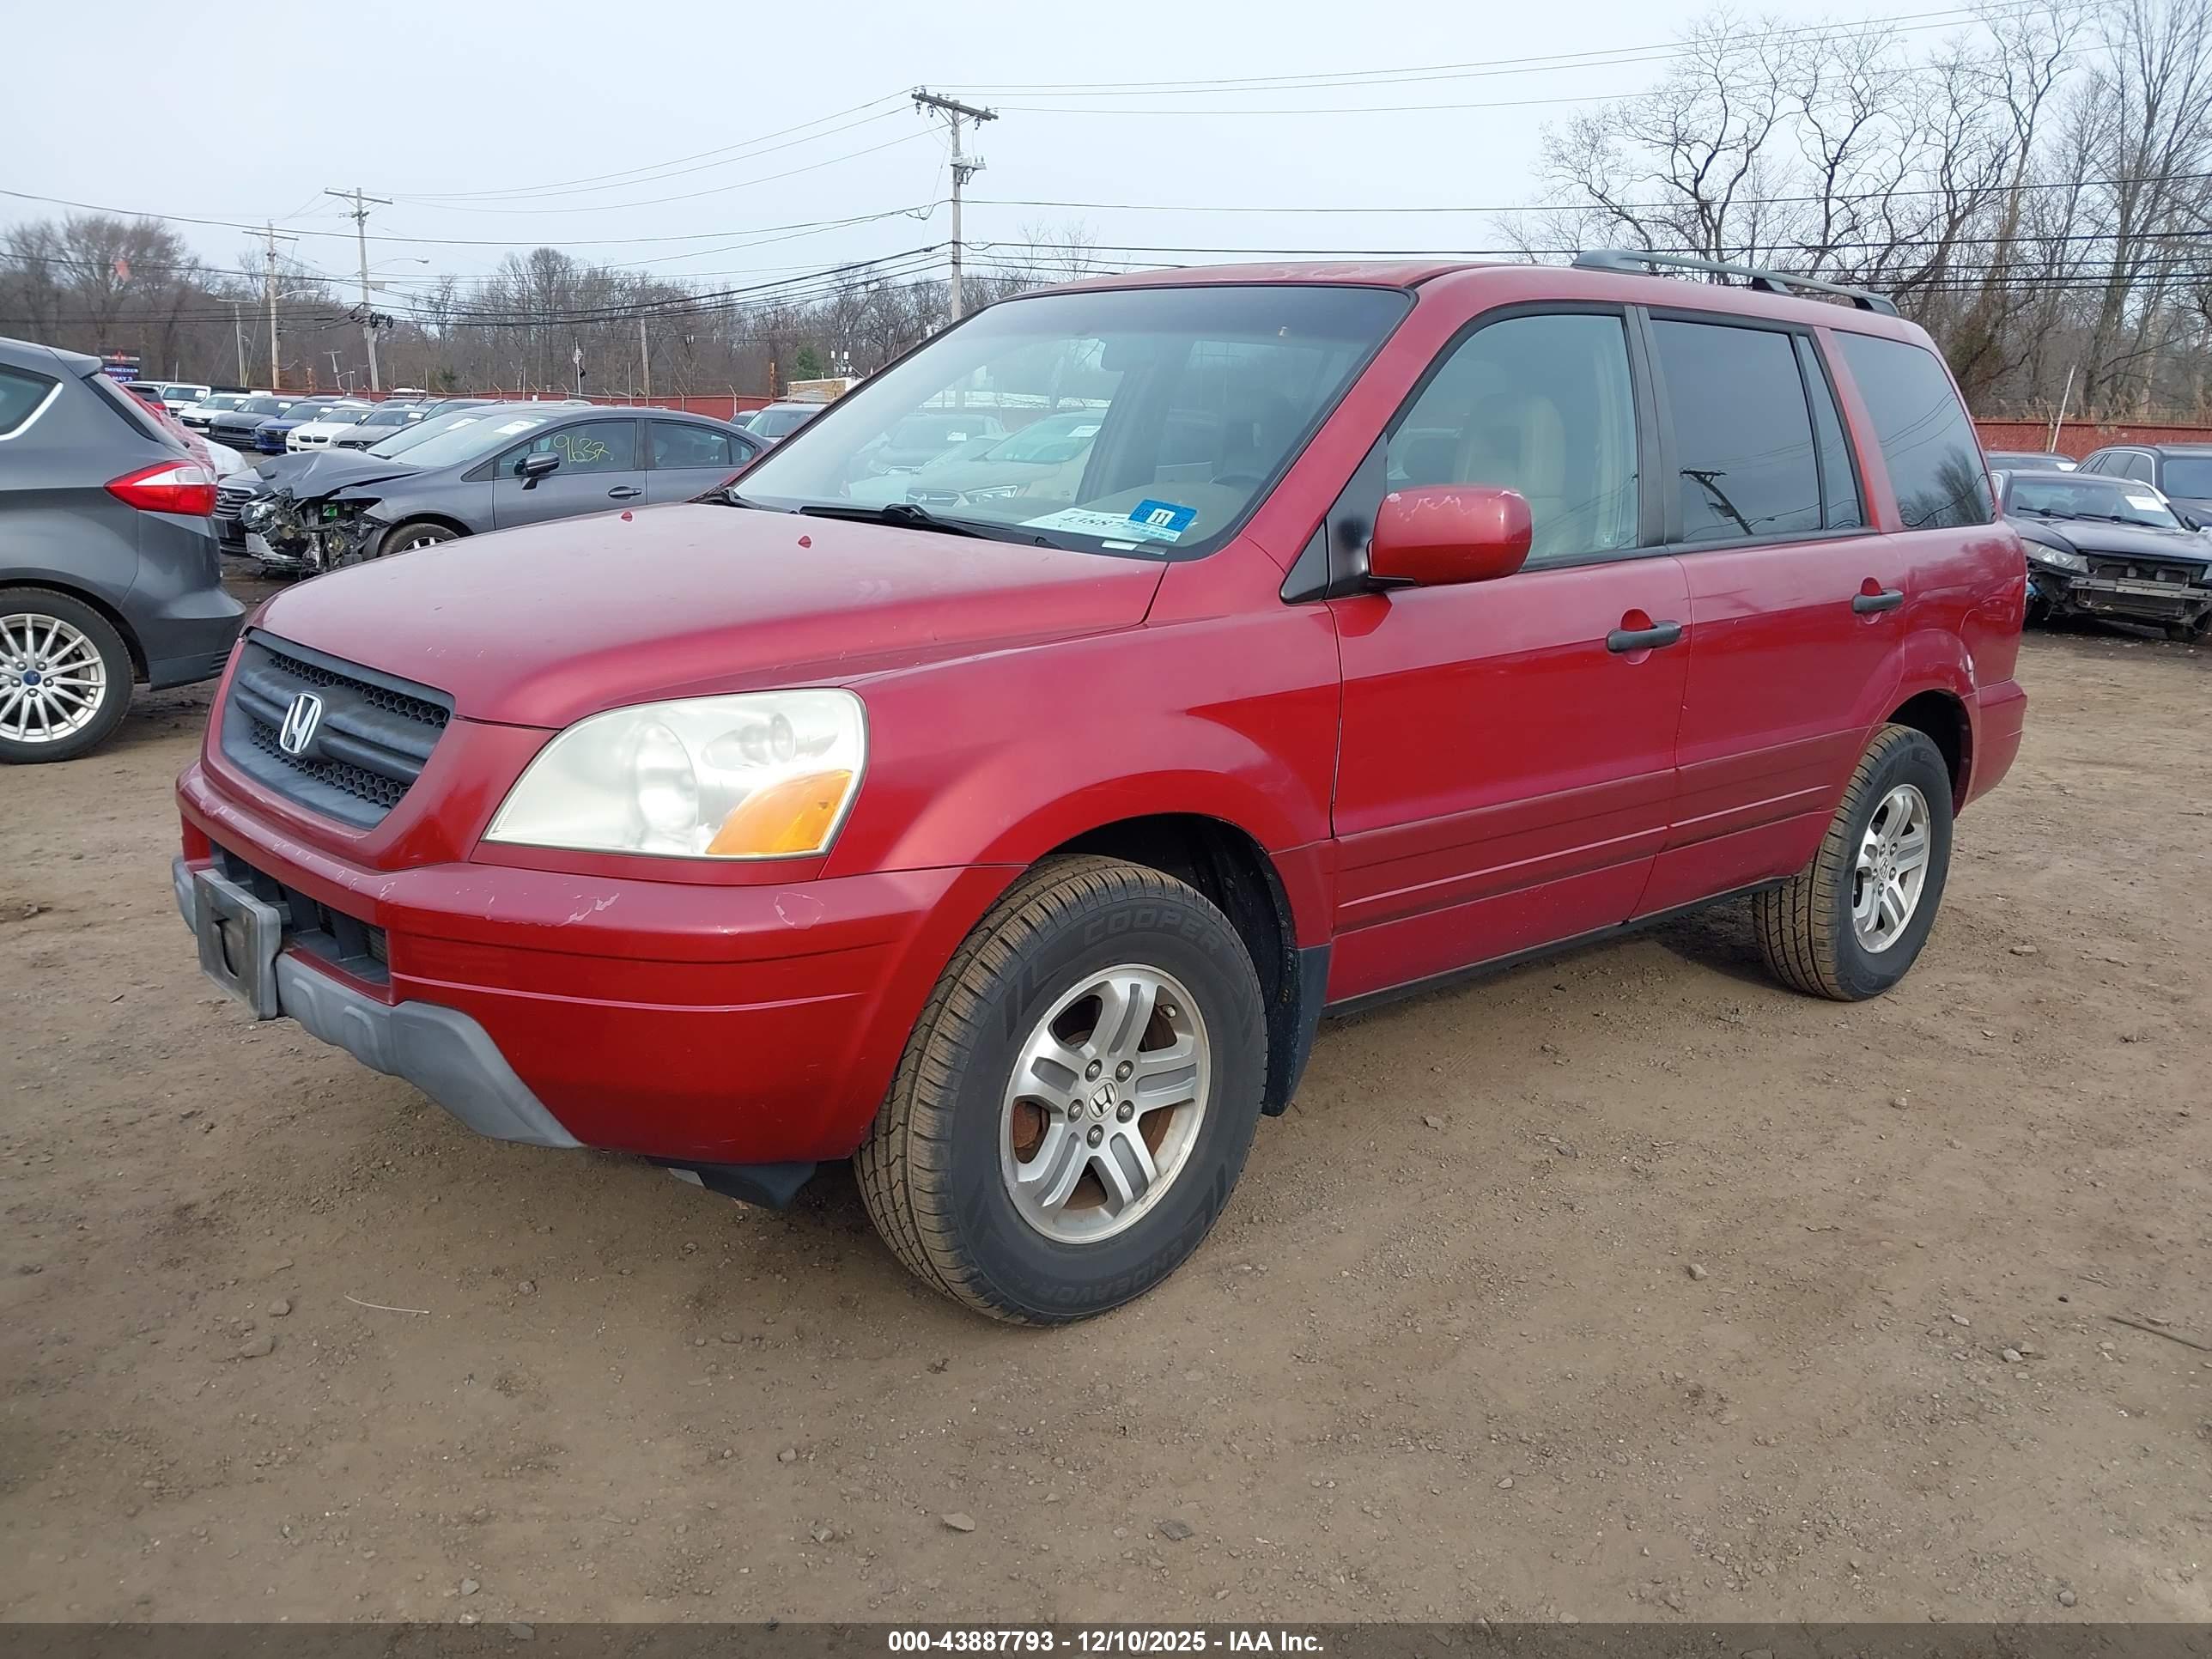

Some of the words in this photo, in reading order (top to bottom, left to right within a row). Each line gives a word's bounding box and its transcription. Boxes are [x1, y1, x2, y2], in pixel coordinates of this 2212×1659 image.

[1151, 511, 1170, 525] 11
[1174, 517, 1188, 526] 27
[1083, 908, 1220, 954] COOPER
